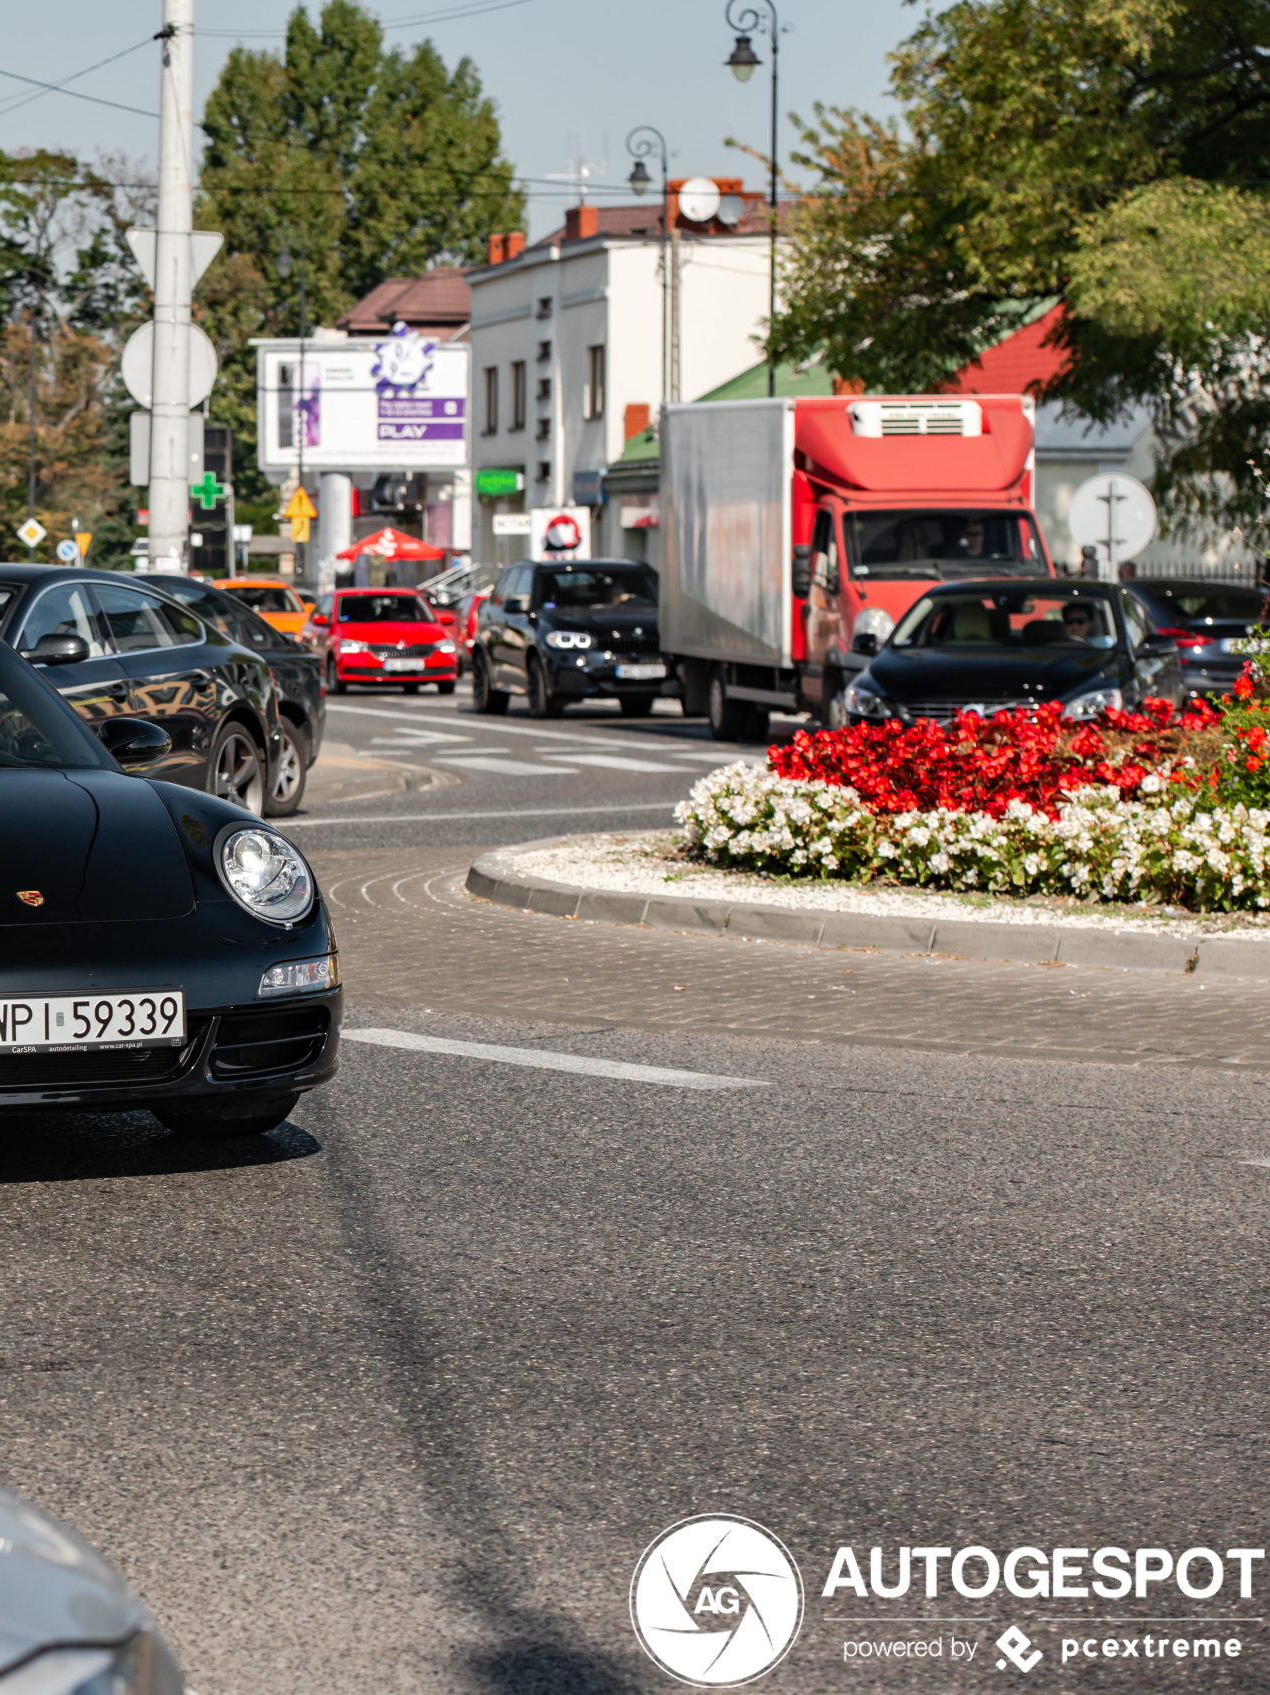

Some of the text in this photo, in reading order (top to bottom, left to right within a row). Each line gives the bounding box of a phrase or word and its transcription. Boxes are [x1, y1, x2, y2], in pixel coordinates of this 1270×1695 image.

[379, 424, 428, 439] PLAY
[72, 996, 178, 1039] 59339
[11, 1041, 143, 1054] CarSPA autodetailing www.car-spa.pl
